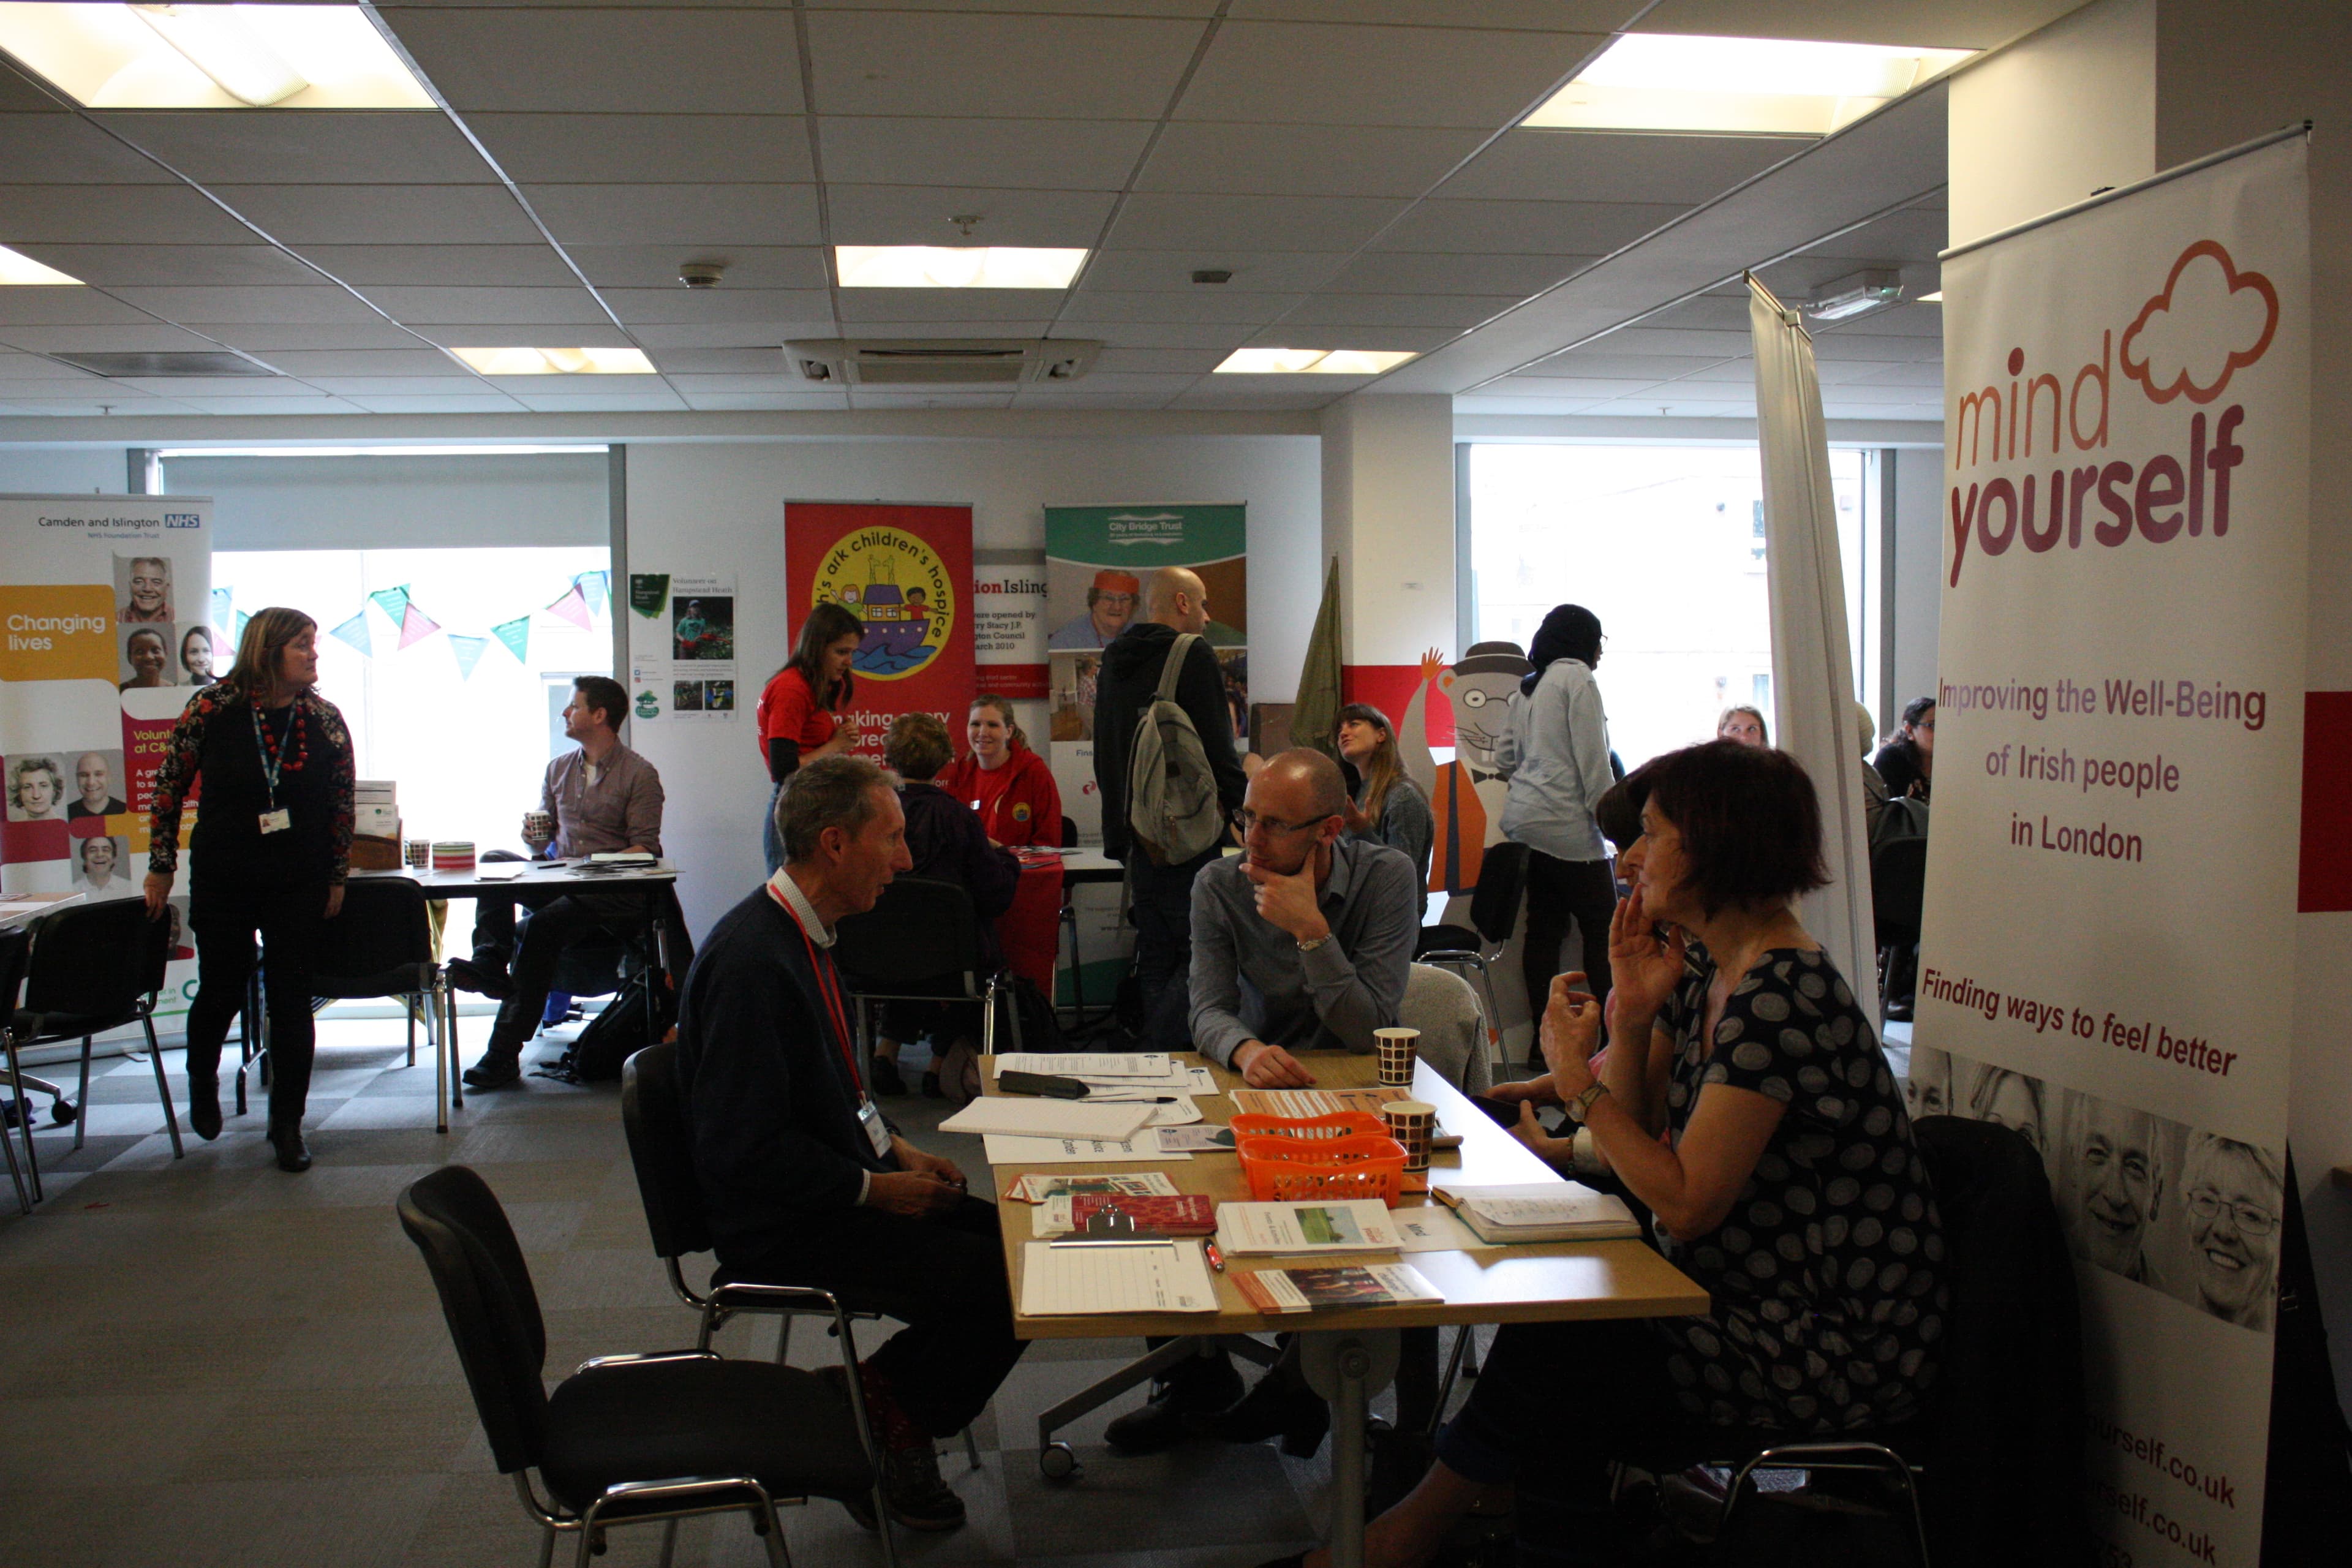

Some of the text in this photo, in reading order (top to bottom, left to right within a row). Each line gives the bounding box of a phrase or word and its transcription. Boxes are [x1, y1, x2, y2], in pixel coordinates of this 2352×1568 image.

[1956, 329, 2111, 470] mind
[1950, 404, 2244, 588] yourself
[38, 514, 199, 529] Camden and Islington NHS
[1109, 522, 1183, 532] City Bridge Trust
[827, 548, 849, 576] ark
[851, 532, 930, 565] children's
[927, 565, 951, 639] hospice
[7, 615, 105, 633] Changing
[1025, 611, 1035, 619] by
[8, 635, 53, 650] lives
[1938, 676, 2266, 731] Improving the Well-Being
[134, 730, 171, 741] Volunt
[134, 744, 146, 753] at
[1986, 744, 2179, 799] of Irish people
[2011, 812, 2143, 862] in London
[1921, 968, 2237, 1077] Finding ways to feel better
